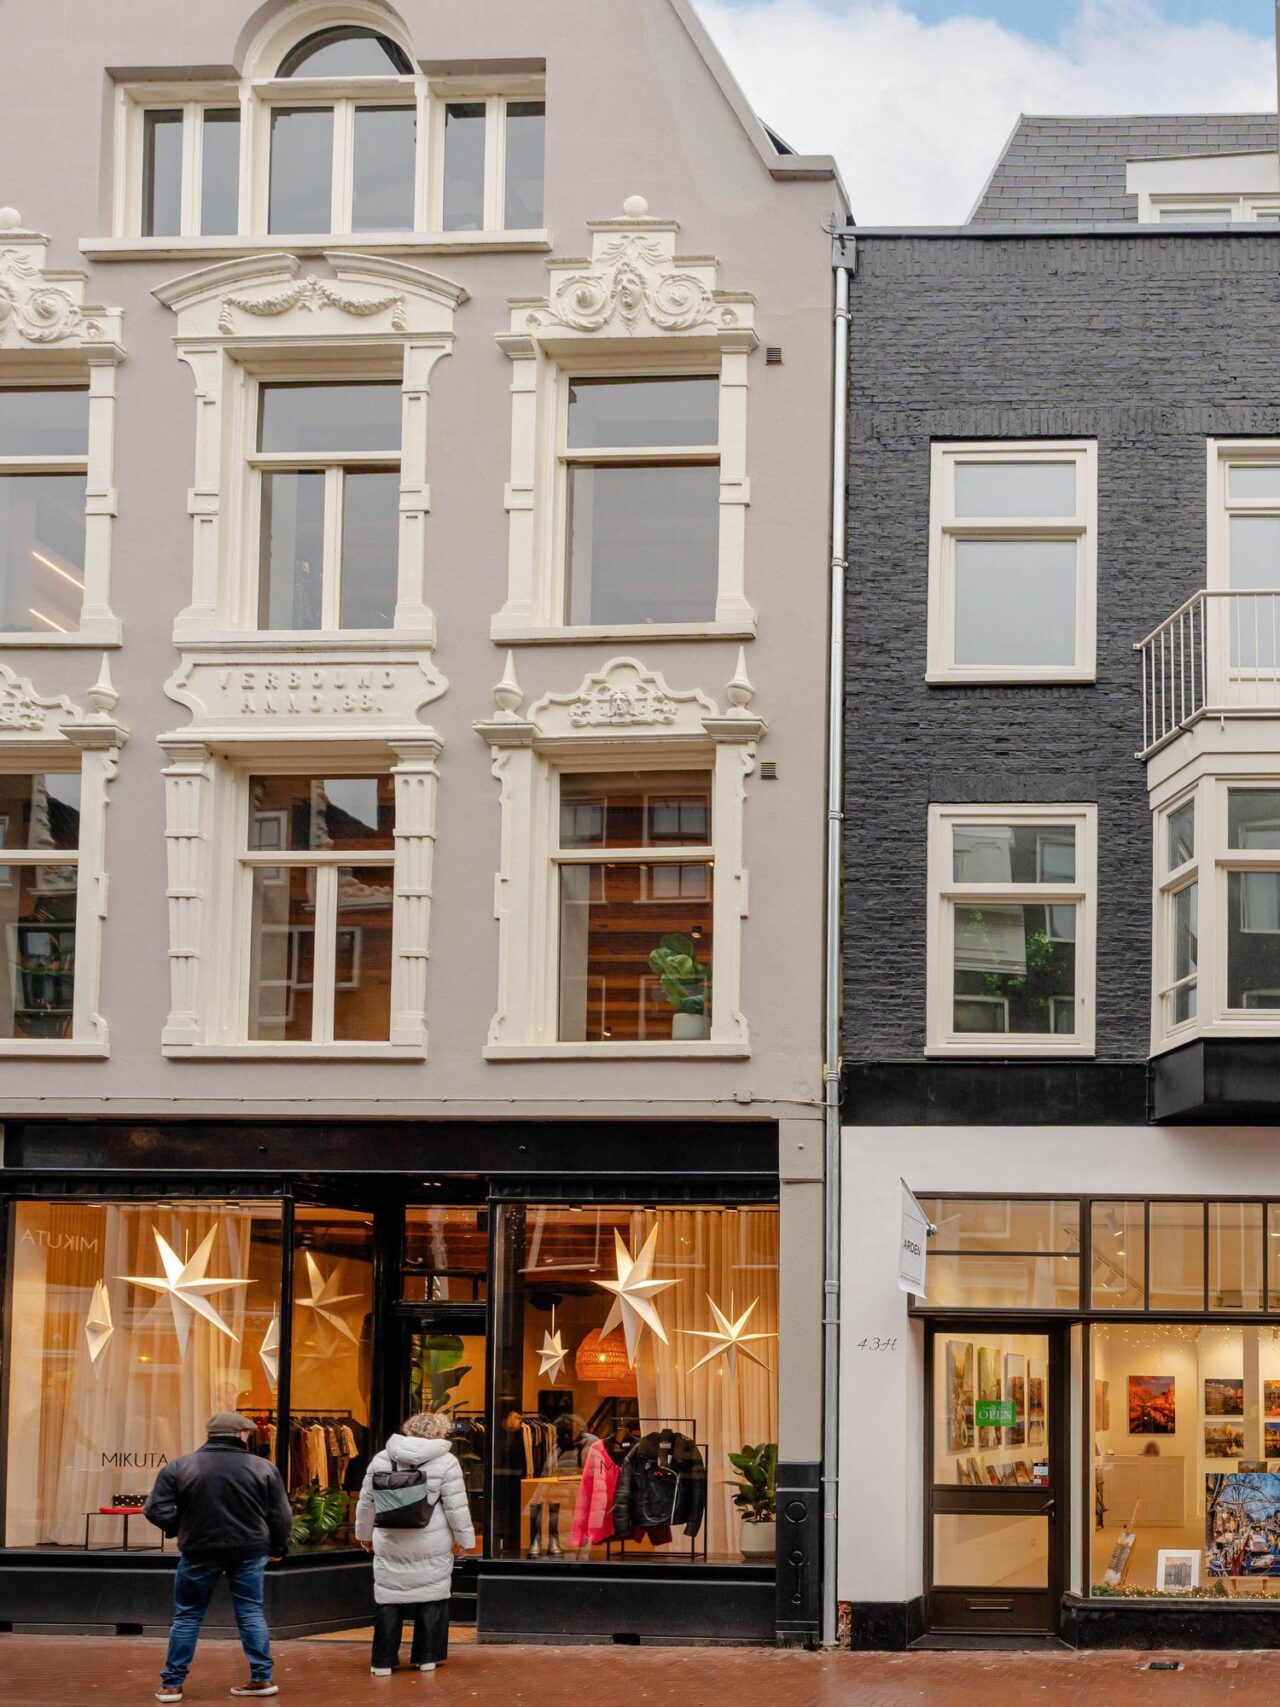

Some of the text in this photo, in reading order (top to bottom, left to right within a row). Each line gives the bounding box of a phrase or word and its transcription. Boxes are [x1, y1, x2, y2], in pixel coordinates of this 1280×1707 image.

[240, 693, 325, 714] ANNO
[978, 1410, 1013, 1420] OPEN
[101, 1451, 169, 1468] MIKUTA
